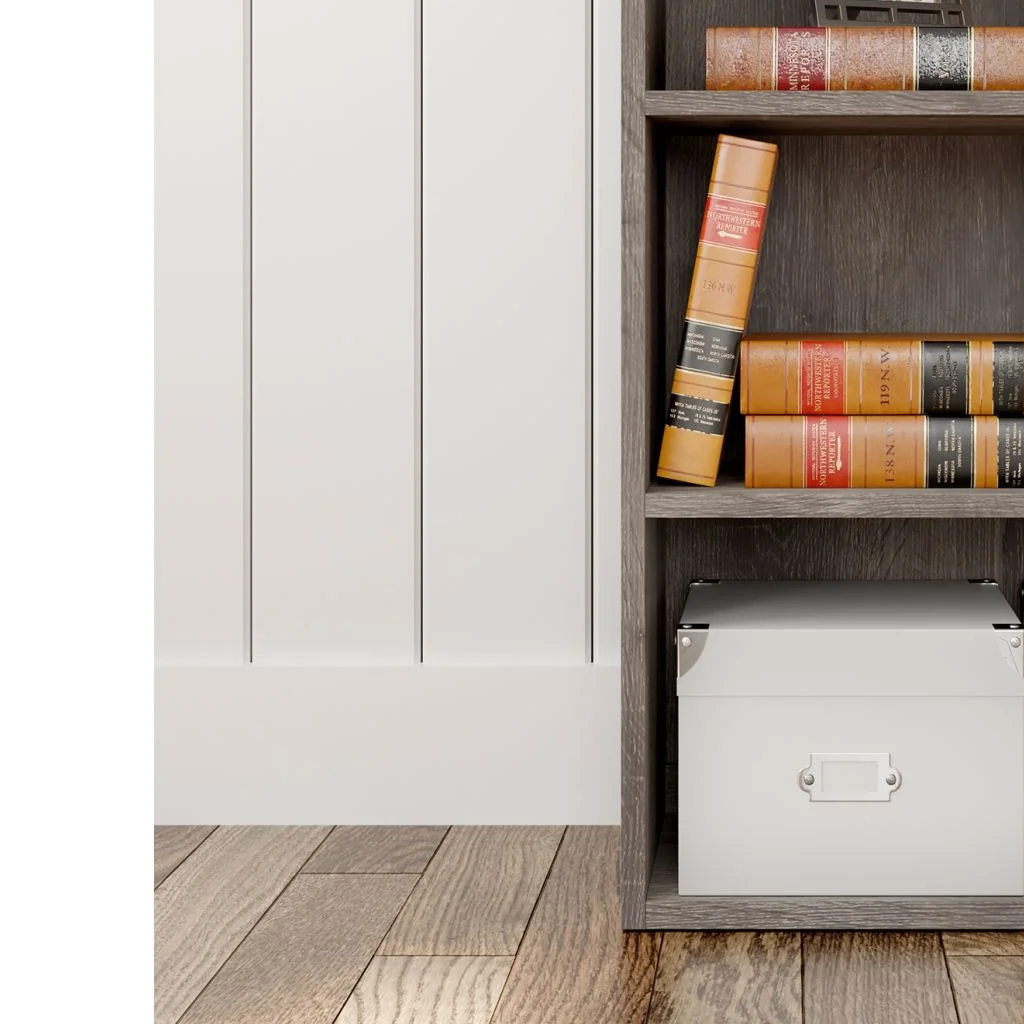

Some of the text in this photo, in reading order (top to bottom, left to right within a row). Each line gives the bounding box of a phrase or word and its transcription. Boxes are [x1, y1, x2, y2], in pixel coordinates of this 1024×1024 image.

[707, 210, 762, 227] NORTHWESTERN
[716, 222, 748, 234] REPORTER
[814, 343, 823, 413] NORTHWESTERN
[823, 354, 832, 401] REPORTER
[880, 384, 891, 406] 119
[818, 418, 828, 487] NORTHWESTERN
[828, 431, 836, 474] REPORTER
